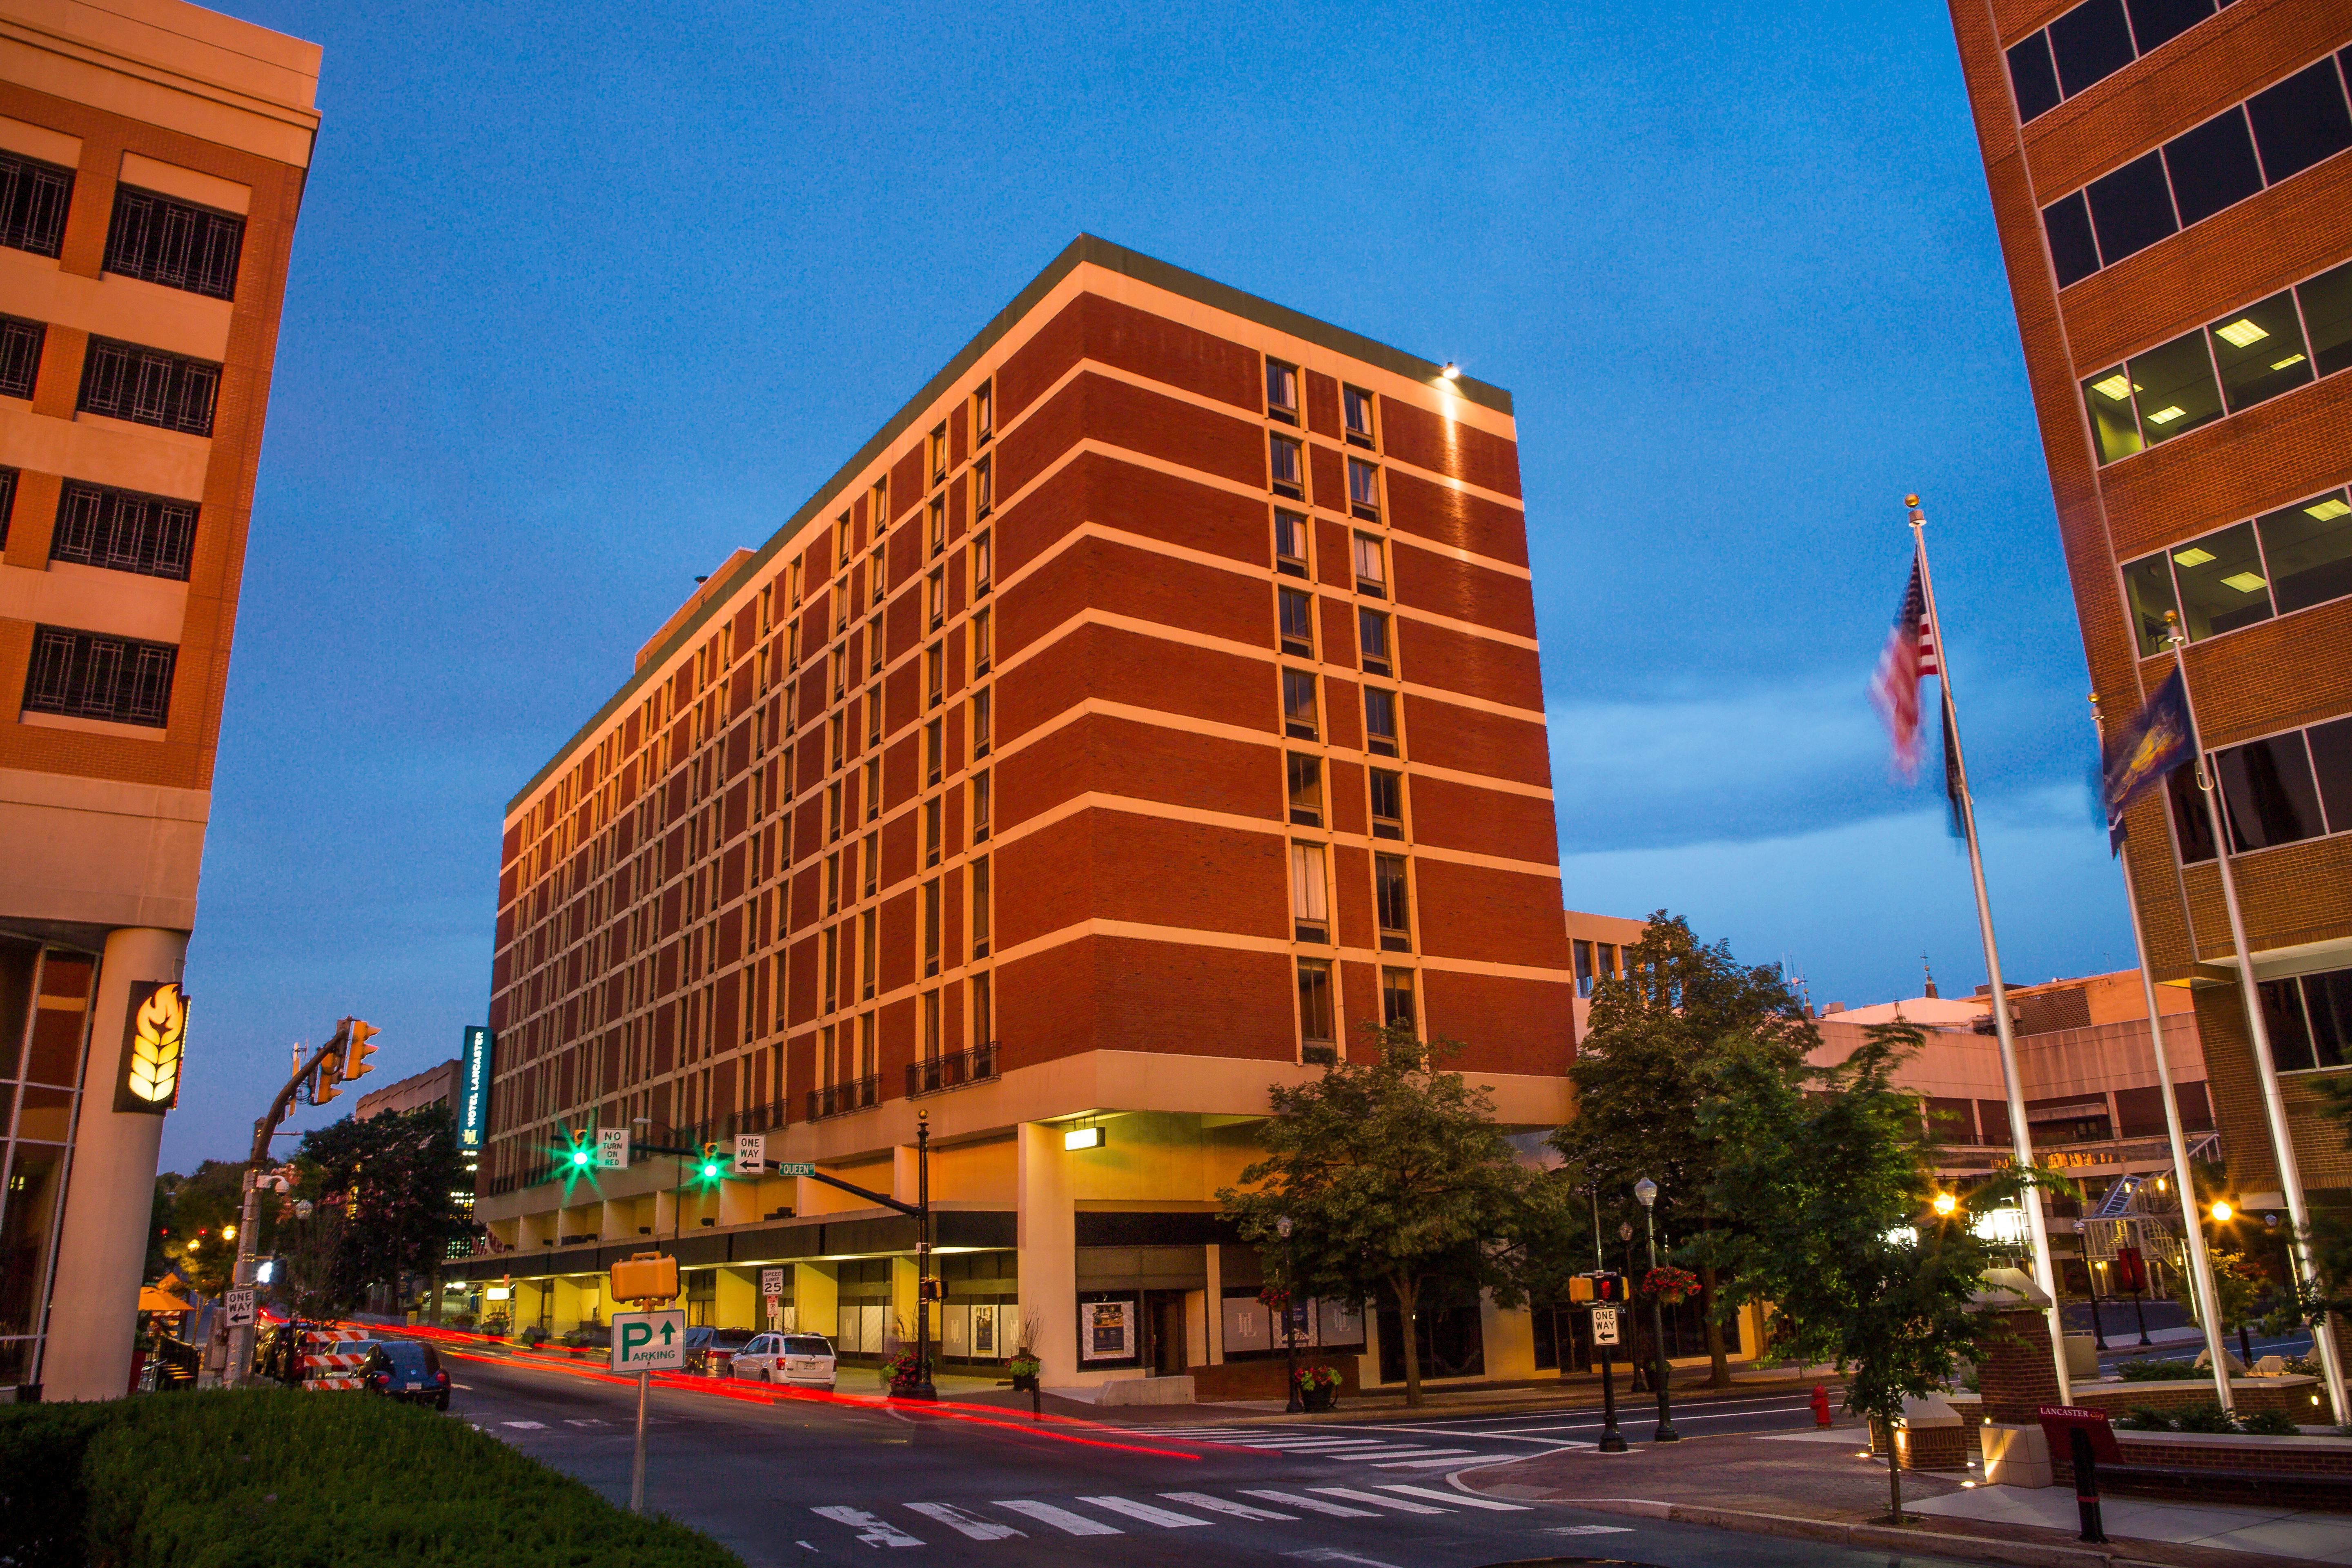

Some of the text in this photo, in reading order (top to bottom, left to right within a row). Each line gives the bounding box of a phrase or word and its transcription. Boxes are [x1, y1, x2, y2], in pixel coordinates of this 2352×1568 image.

[470, 1031, 483, 1091] LANCASTER
[468, 1093, 478, 1127] HOTEL
[604, 1131, 621, 1140] NO
[741, 1138, 760, 1147] ONE
[740, 1149, 759, 1158] WAY
[784, 1164, 808, 1174] QUEEN
[764, 1282, 782, 1292] 25
[229, 1292, 252, 1302] ONE
[229, 1302, 252, 1313] WAY
[1596, 1311, 1614, 1320] ONE
[1596, 1321, 1615, 1330] WAY
[622, 1322, 675, 1363] PARKING
[2040, 1408, 2089, 1417] LANCASTER
